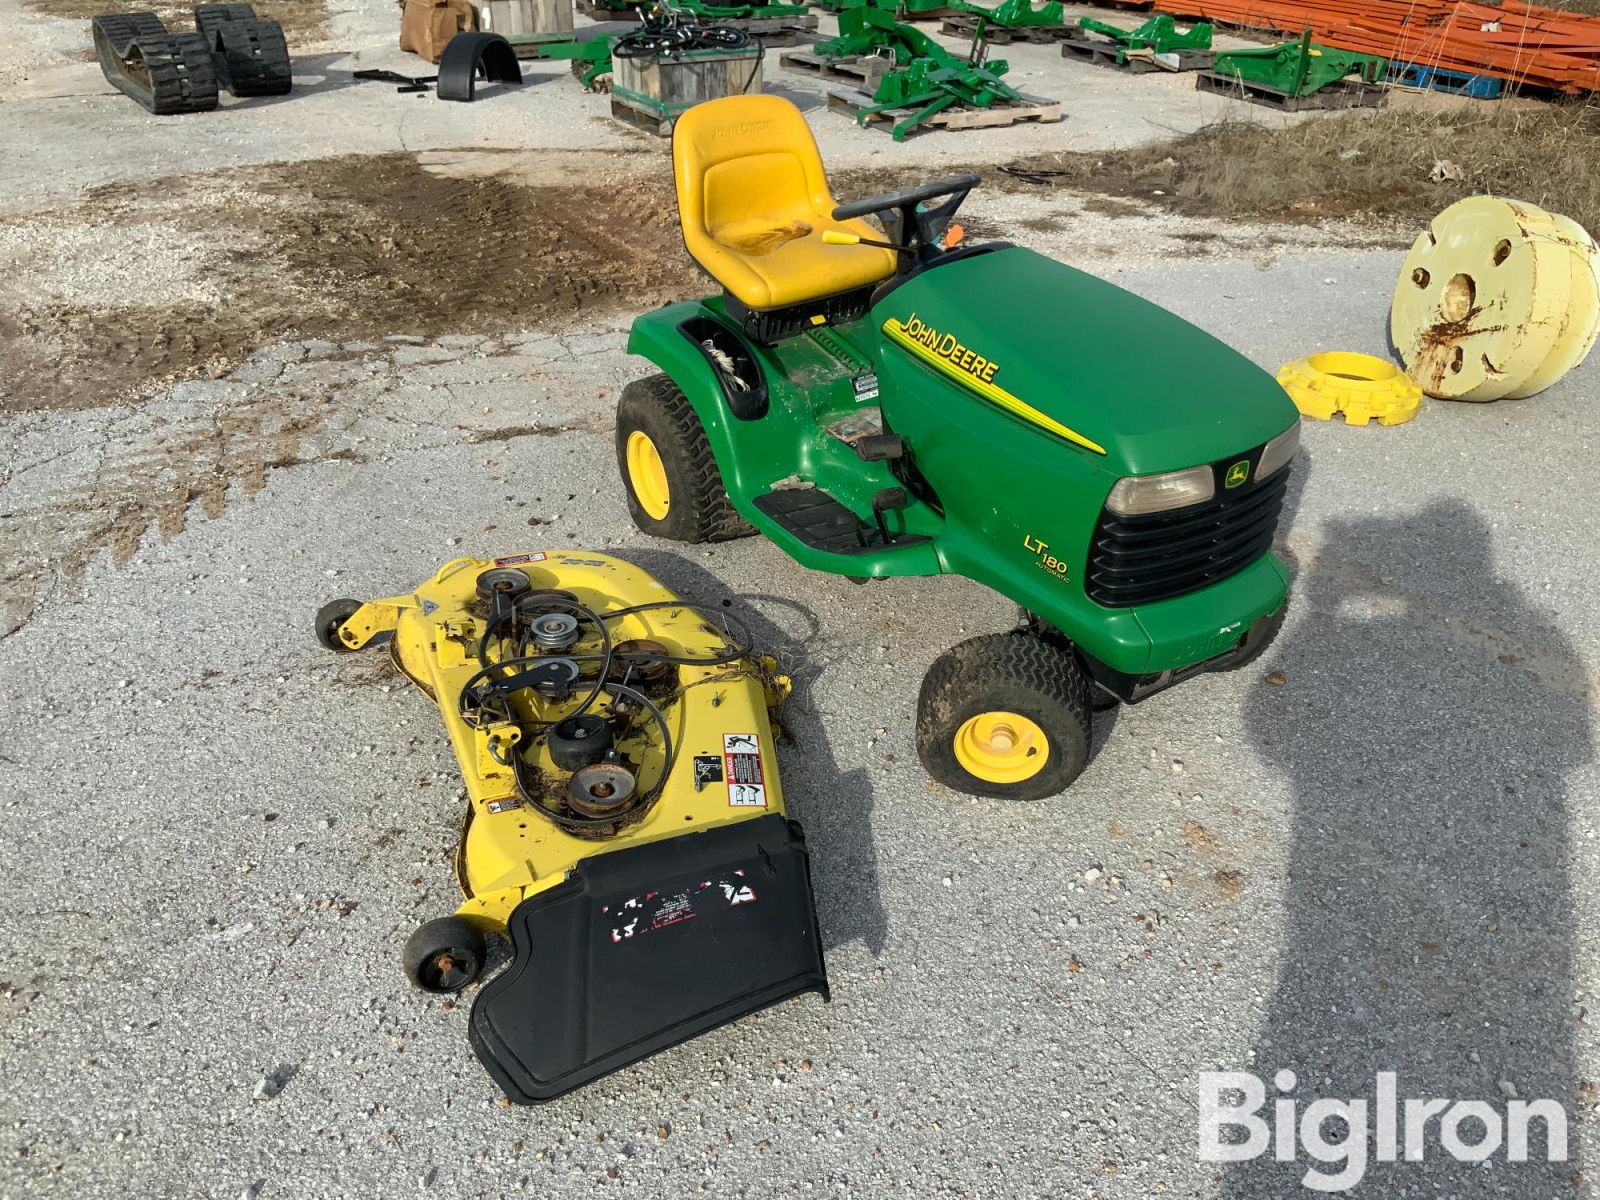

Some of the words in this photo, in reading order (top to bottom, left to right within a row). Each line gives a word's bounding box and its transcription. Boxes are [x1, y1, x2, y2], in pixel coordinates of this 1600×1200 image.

[1023, 534, 1049, 554] LT
[1035, 561, 1070, 584] AUTOMATIC
[1042, 553, 1067, 574] 180
